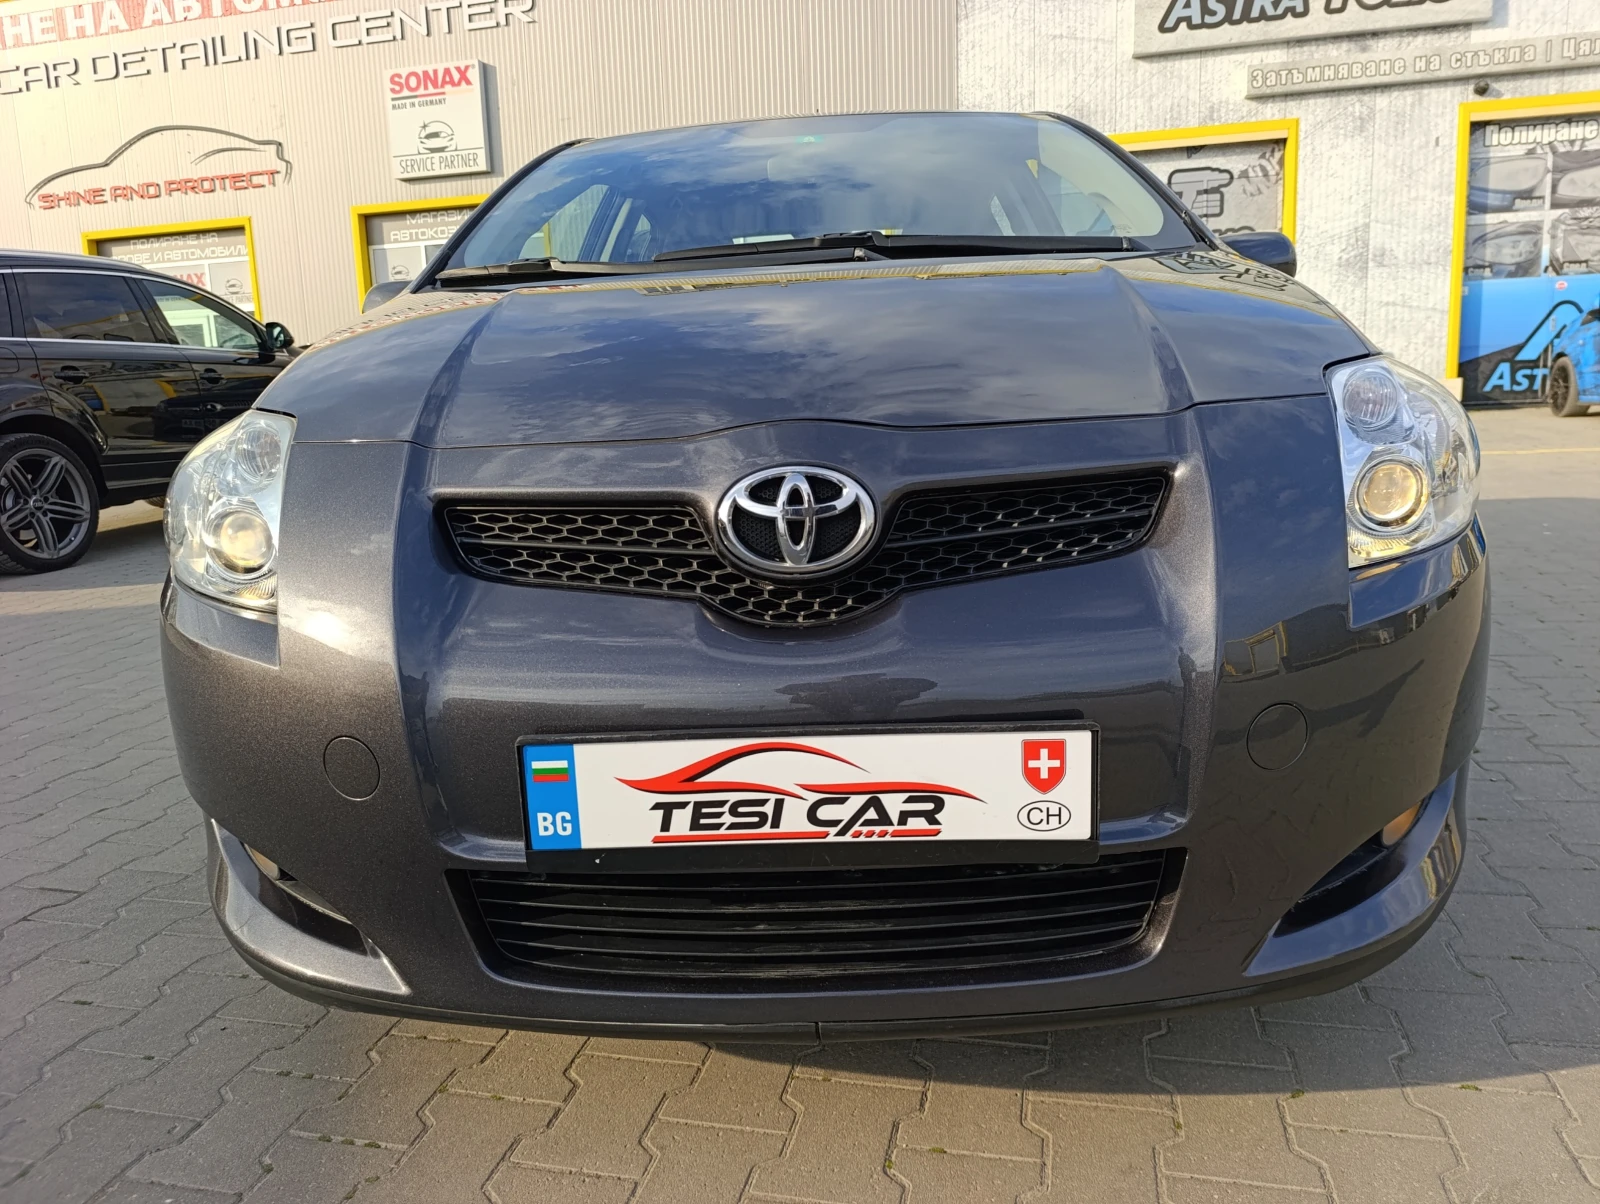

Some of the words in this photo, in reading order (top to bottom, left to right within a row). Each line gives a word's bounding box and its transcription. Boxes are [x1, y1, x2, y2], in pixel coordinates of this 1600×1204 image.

[0, 10, 57, 49] НЕ
[64, 0, 129, 40] НА
[0, 59, 81, 95] CAR
[90, 22, 316, 83] DETAILING
[328, 0, 538, 48] CENTER
[389, 65, 473, 94] SONAX
[1251, 57, 1406, 88] Затъмняване
[1413, 53, 1441, 74] на
[1450, 44, 1536, 69] стъкла
[391, 102, 407, 111] MADE
[409, 101, 416, 109] IN
[418, 97, 446, 108] GERMANY
[1484, 119, 1599, 147] Полиране
[399, 156, 435, 174] SERVICE
[439, 152, 479, 171] PARTNER
[37, 188, 107, 210] SHINE
[110, 182, 161, 203] AND
[164, 169, 280, 197] PROTECT
[130, 234, 198, 250] ПОЛИРАНЕ
[200, 232, 219, 243] НА
[390, 226, 459, 242] АВТОКОЗ
[153, 251, 162, 262] И
[536, 811, 573, 837] BG
[649, 797, 786, 833] TESI
[806, 794, 945, 837] CAR
[1026, 806, 1062, 827] CH
